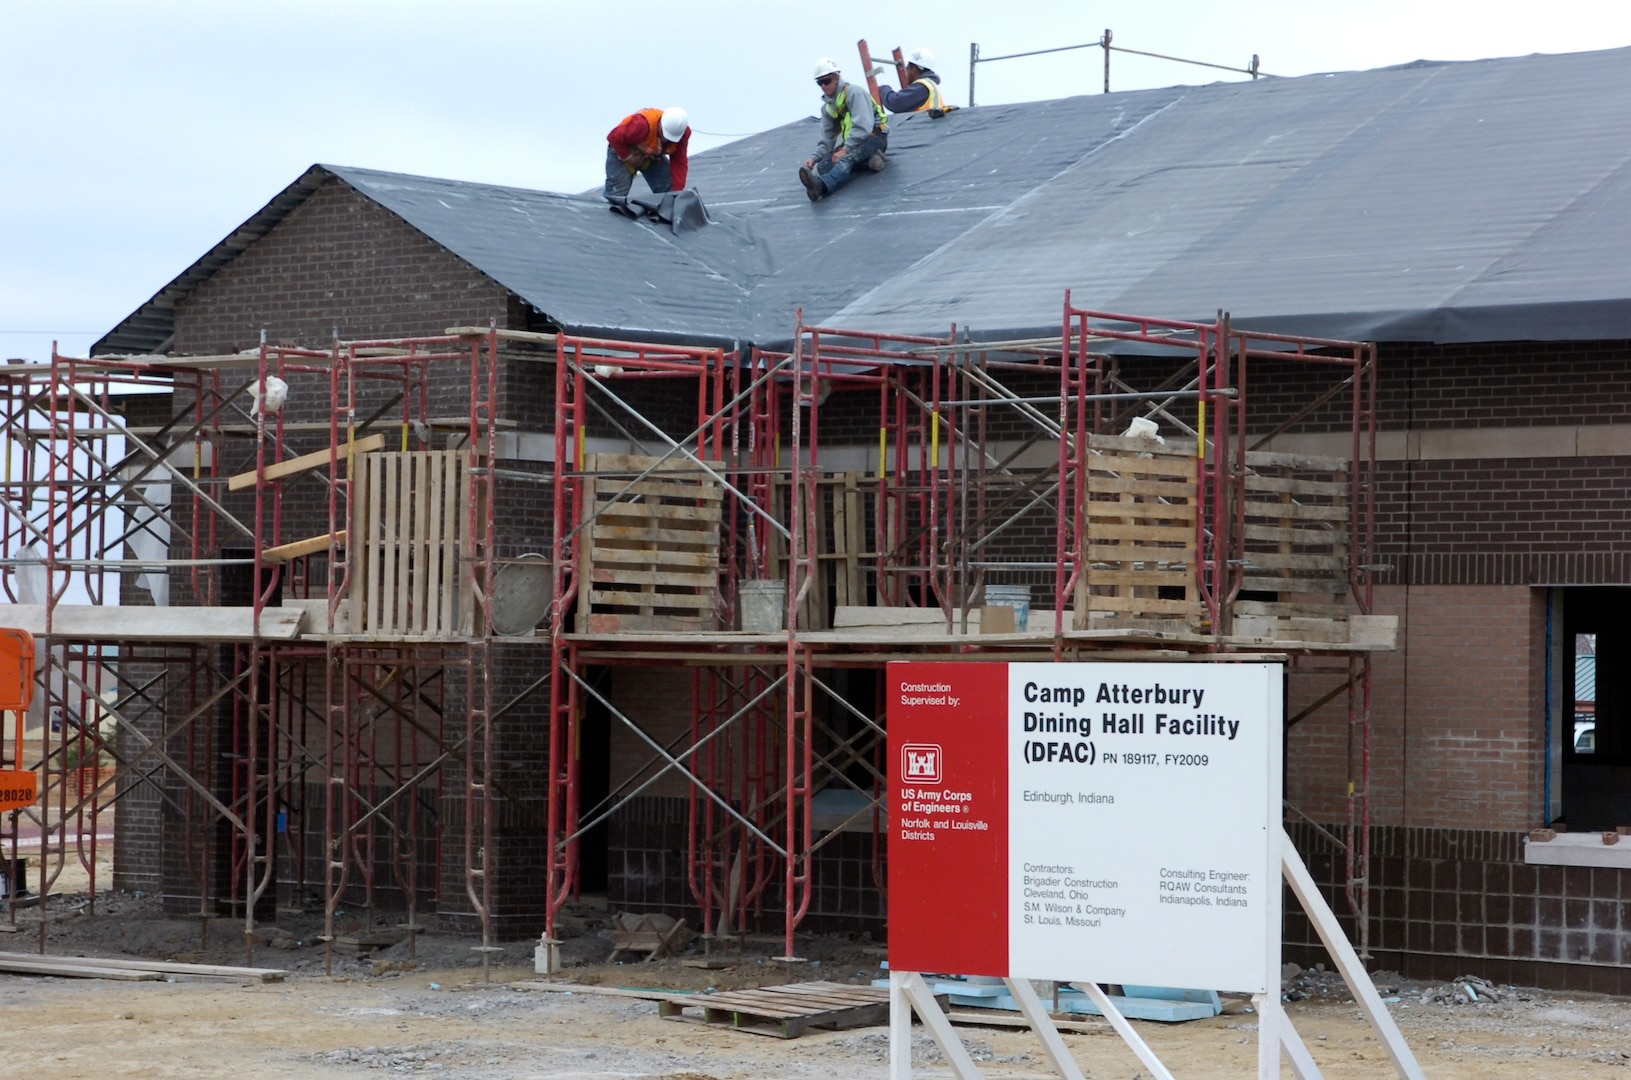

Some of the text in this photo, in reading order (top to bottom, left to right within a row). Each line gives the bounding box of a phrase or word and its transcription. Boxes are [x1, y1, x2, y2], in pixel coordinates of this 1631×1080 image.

[901, 681, 952, 693] Construction
[901, 695, 961, 708] Supervised by:
[1024, 681, 1205, 710] Camp Atterbury
[1024, 711, 1241, 741] Dining Hall Facility
[1024, 740, 1210, 767] (DFAC) PN 189117, FY2009
[901, 788, 973, 802] US Army Corps
[1023, 790, 1116, 806] Edinburgh, Indiana
[901, 801, 962, 815] of Engineers
[901, 817, 989, 832] Norfolk and Louisville
[901, 829, 936, 842] Districts
[1023, 862, 1075, 875] Contractors:
[1159, 867, 1252, 883] Consulting Engineer:
[1023, 875, 1119, 890] Brigadier Construction
[1159, 881, 1248, 895] RQAW Consultants
[1023, 887, 1090, 901] Cleveland, Ohio
[1159, 894, 1249, 908] Indianapolis, Indiana
[1044, 902, 1074, 914] Wilson
[1075, 904, 1082, 915] &
[1084, 904, 1127, 919] Company
[1038, 915, 1063, 927] Louis,
[1064, 916, 1102, 928] Missouri
